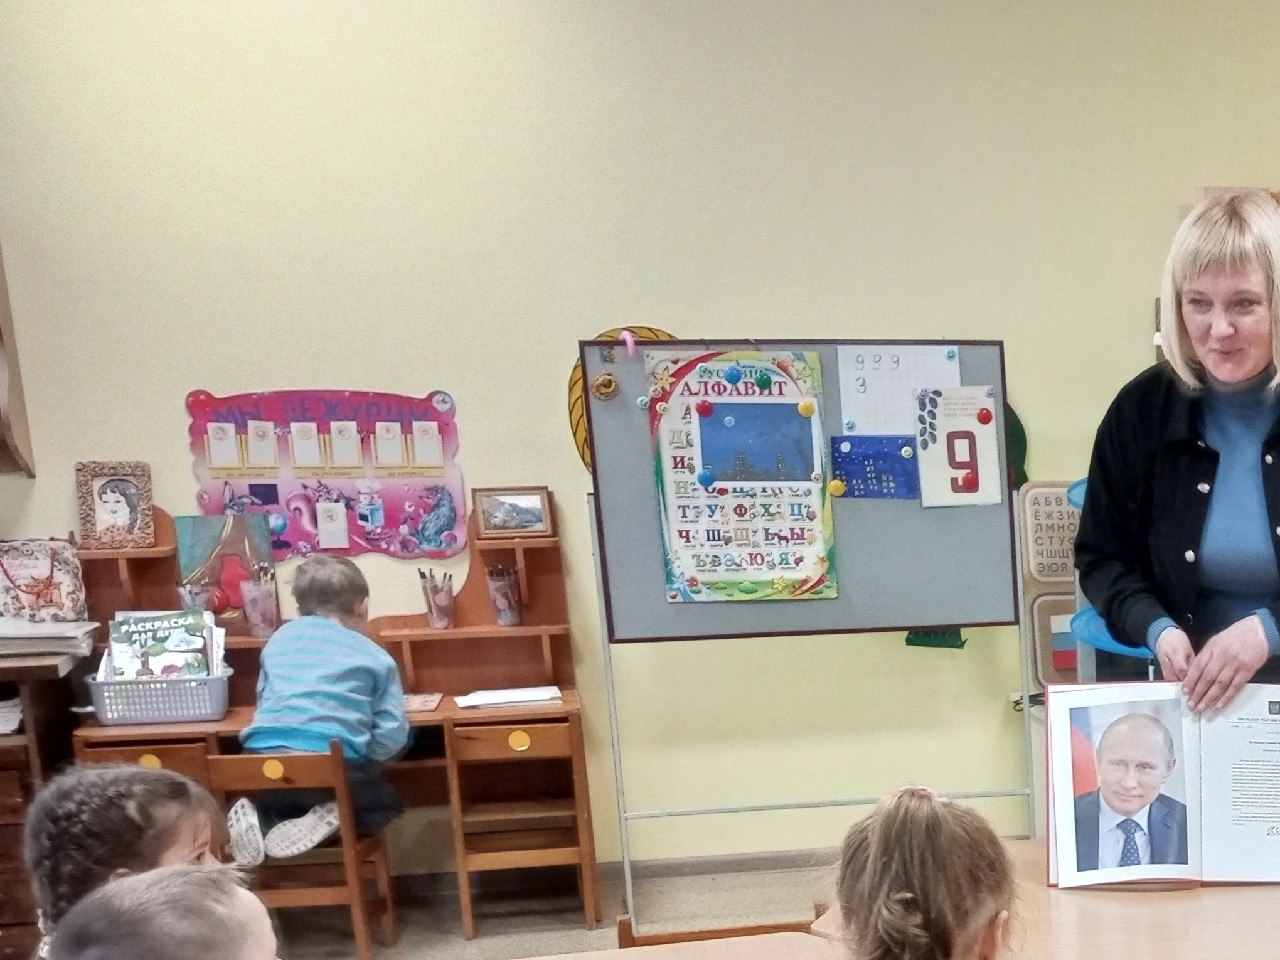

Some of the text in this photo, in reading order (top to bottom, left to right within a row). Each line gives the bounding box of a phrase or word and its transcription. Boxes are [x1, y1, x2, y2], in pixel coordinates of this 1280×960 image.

[856, 354, 900, 371] 9 9 9
[855, 377, 867, 394] 3
[672, 456, 687, 469] И
[946, 430, 980, 494] 9
[678, 505, 690, 518] Т
[705, 504, 719, 518] У
[733, 504, 748, 518] Ф
[760, 503, 774, 517] Х
[677, 530, 691, 543] Ч
[705, 529, 721, 542] Ш
[748, 553, 765, 566] Ю
[778, 552, 791, 566] Я
[120, 616, 195, 634] РАСКРАСКА
